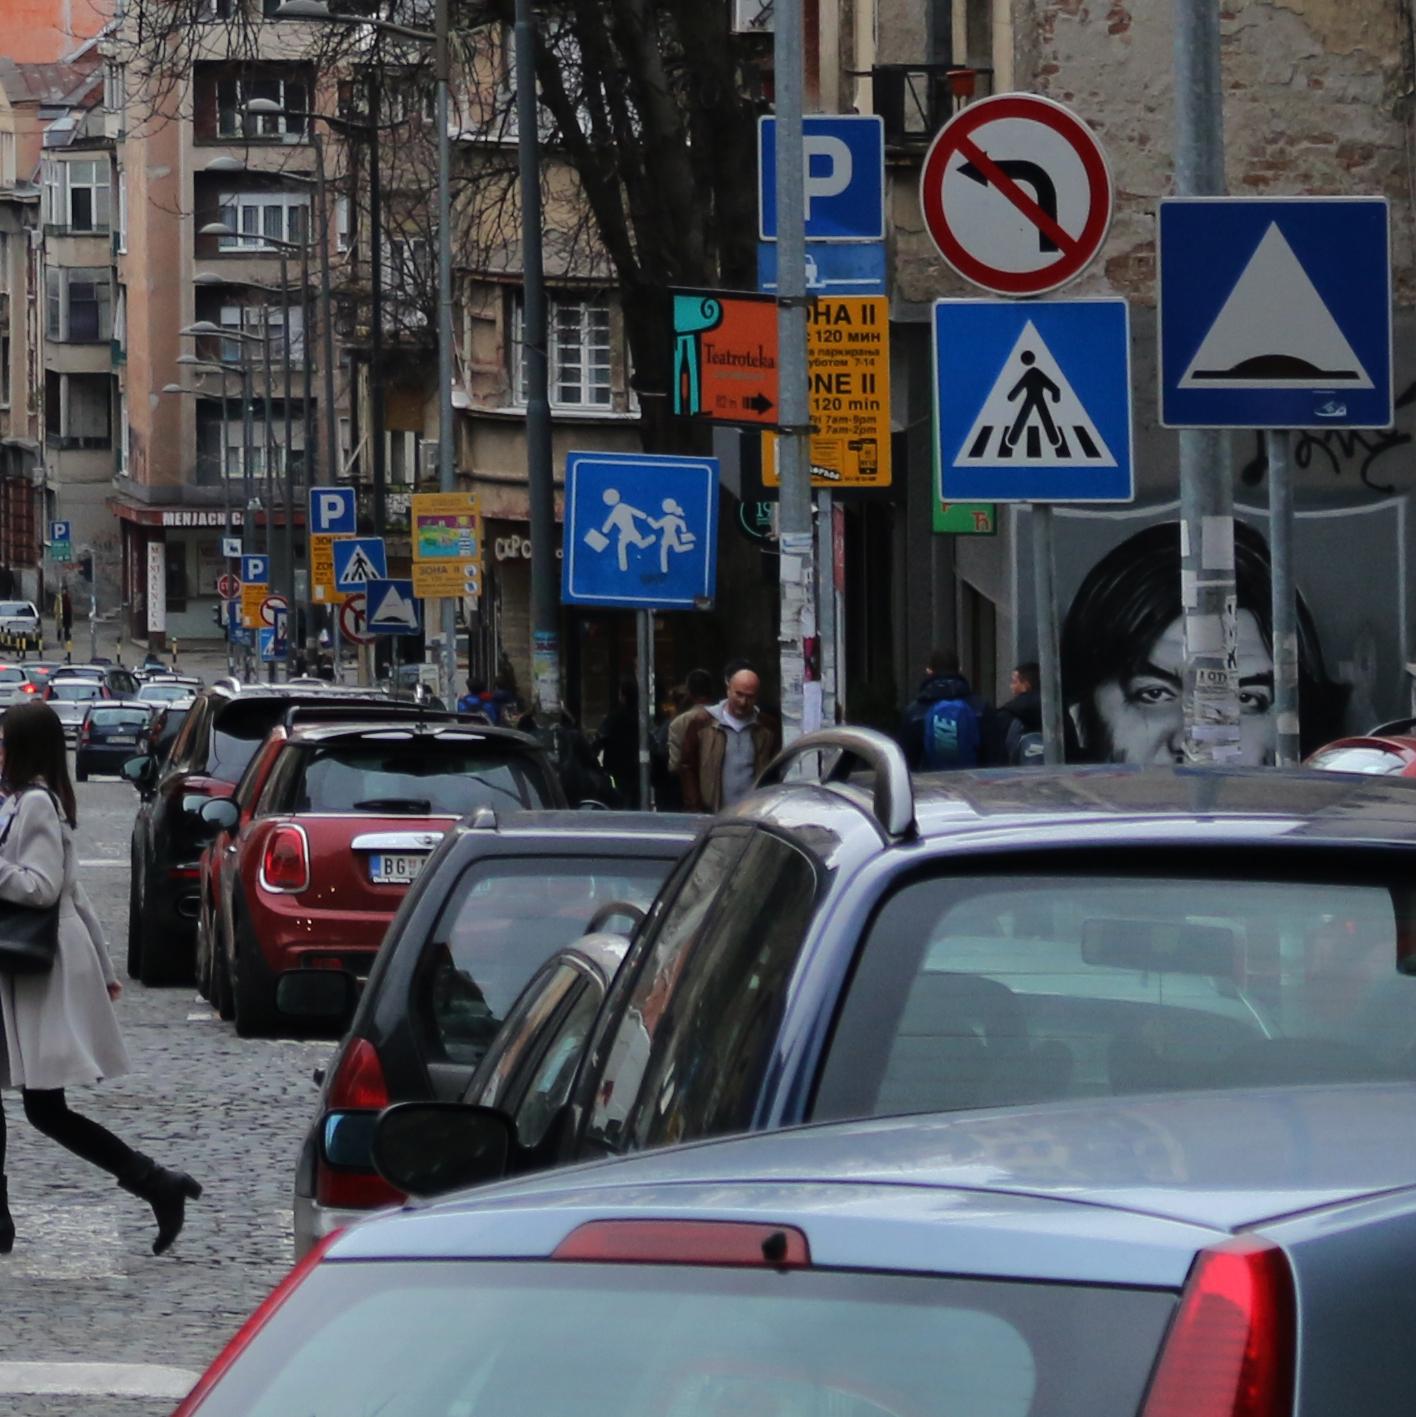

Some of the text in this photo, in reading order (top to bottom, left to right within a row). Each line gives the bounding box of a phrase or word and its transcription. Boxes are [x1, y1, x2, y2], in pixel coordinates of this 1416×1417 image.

[802, 135, 852, 221] P
[862, 304, 875, 325] II
[816, 330, 880, 343] 120 мин
[703, 342, 776, 369] Teatroteka
[818, 348, 880, 358] паркирања
[855, 358, 875, 367] 7-14
[862, 374, 875, 394] II
[813, 398, 880, 411] 120 min
[826, 415, 877, 426] 7am-9pm
[826, 426, 877, 436] 7am-2pm
[319, 494, 345, 529] P
[54, 523, 66, 540] P
[248, 559, 264, 580] P
[419, 565, 448, 575] ЗОНА
[384, 858, 406, 875] BG
